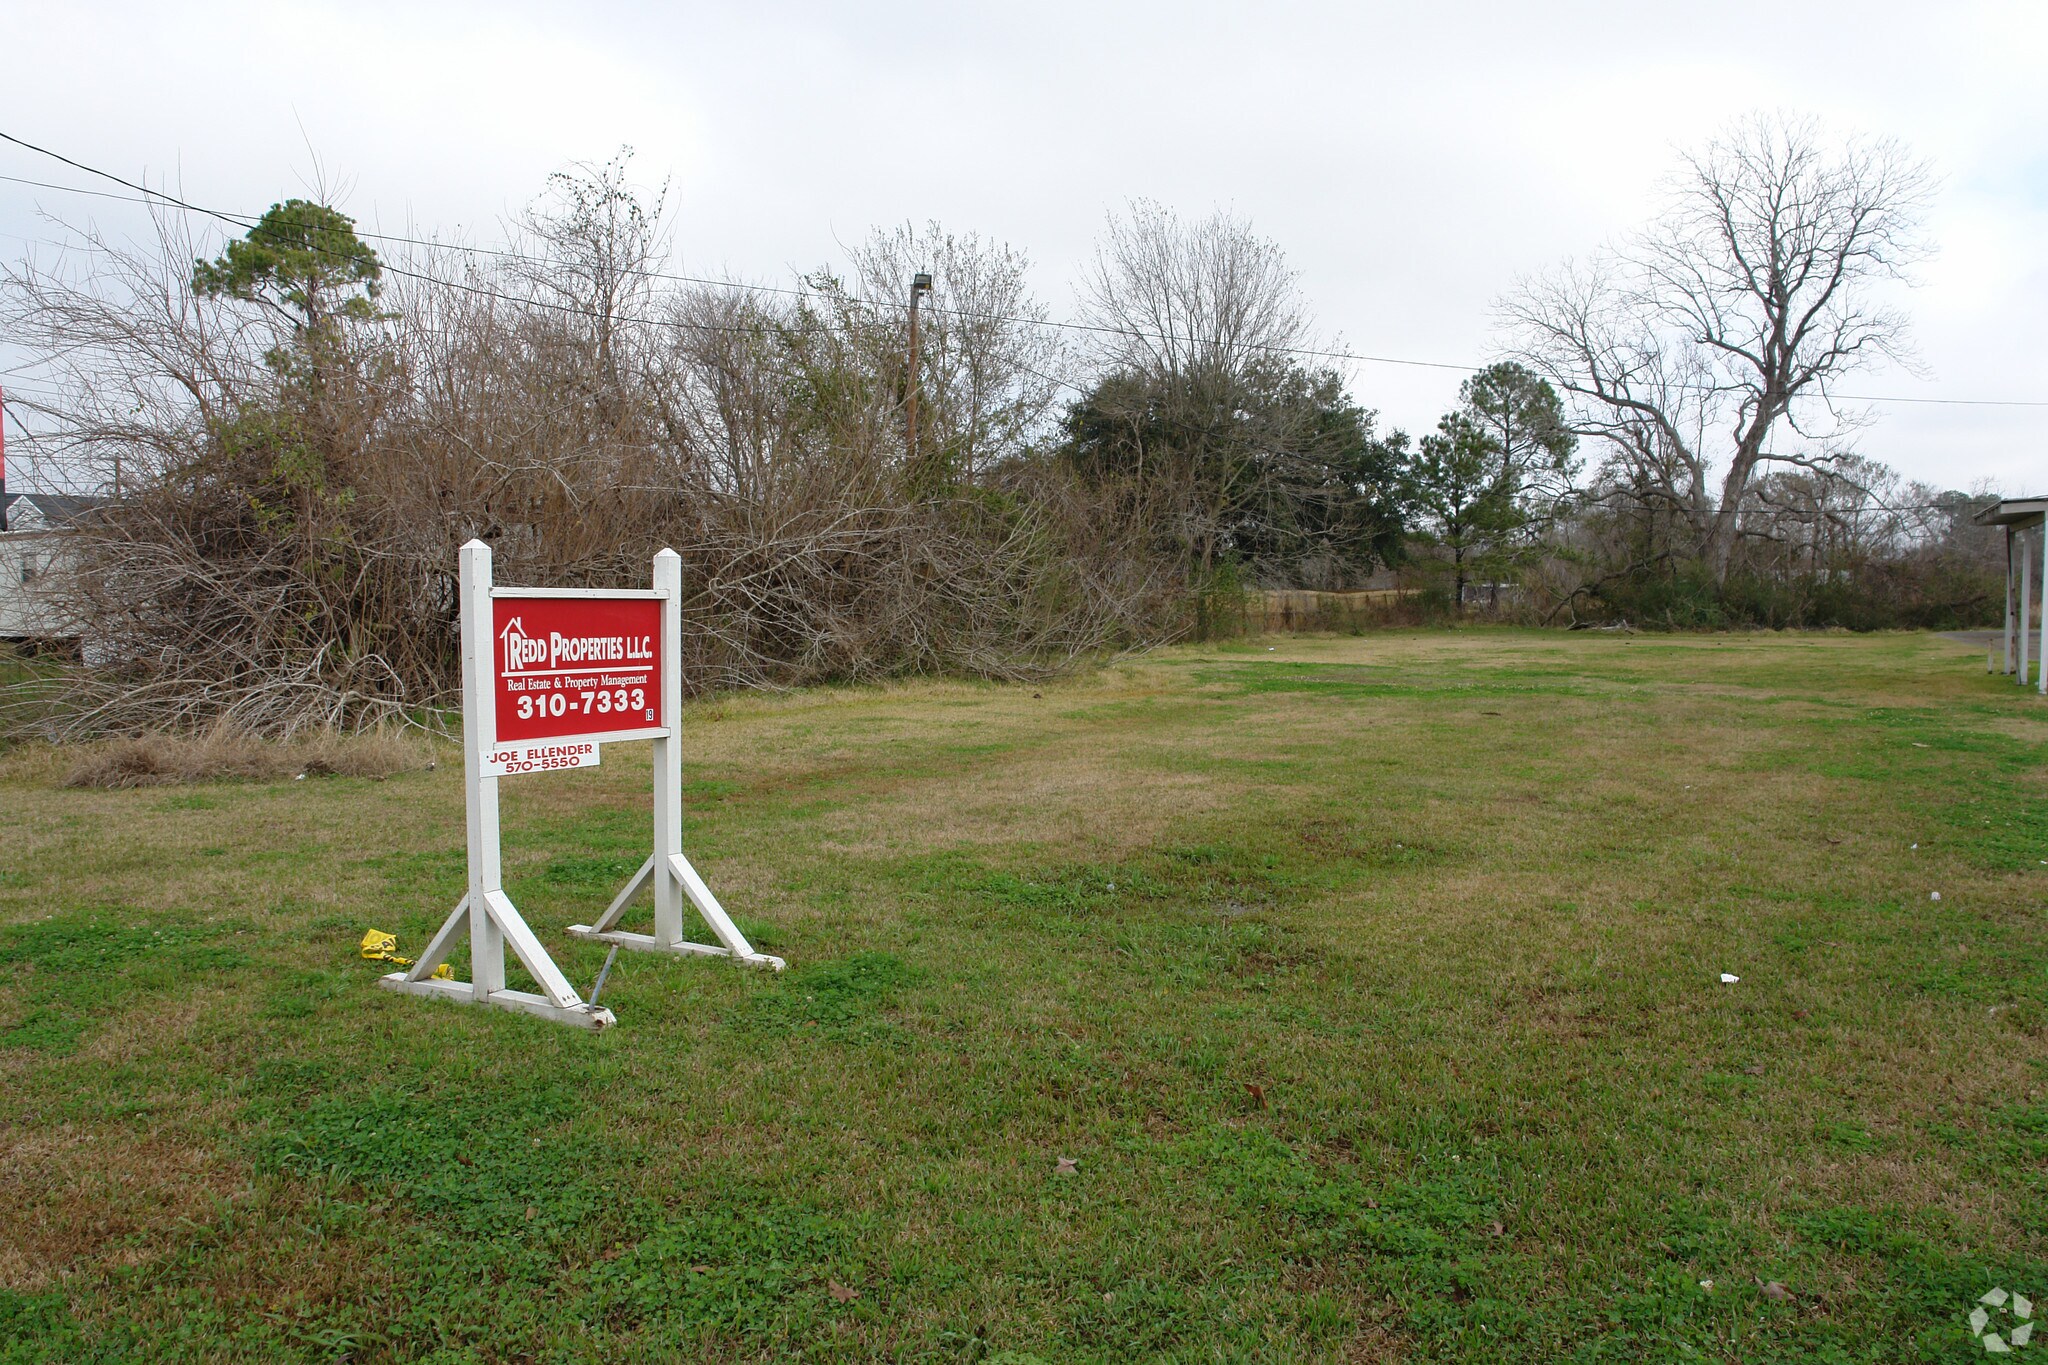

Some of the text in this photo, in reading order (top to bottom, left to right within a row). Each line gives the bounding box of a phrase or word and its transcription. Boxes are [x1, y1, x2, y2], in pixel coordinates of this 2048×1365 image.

[550, 632, 623, 668] PROPERTIES
[508, 674, 647, 691] Real Estate & Property Management
[517, 688, 645, 720] 310-7333
[490, 744, 592, 763] JOE ELLENDER
[506, 756, 580, 773] 570-5550
